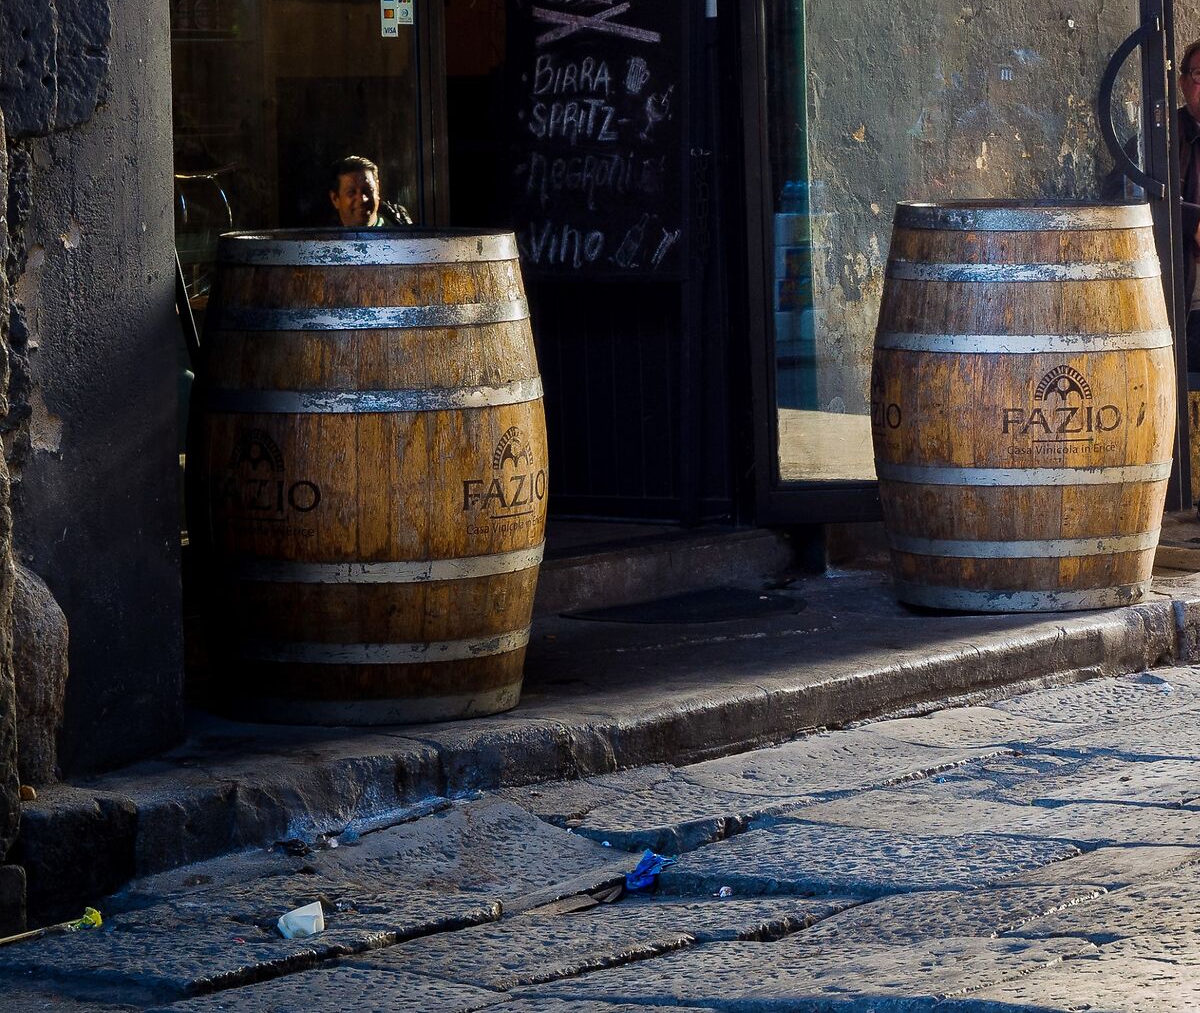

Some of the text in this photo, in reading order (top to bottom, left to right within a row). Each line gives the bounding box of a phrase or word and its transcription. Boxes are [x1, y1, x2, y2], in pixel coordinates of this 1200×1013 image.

[872, 402, 901, 429] ZIO
[1002, 404, 1121, 434] FAZIO
[1007, 444, 1115, 455] Casa Vinicola in Erice
[207, 479, 321, 512] AZIO
[463, 469, 546, 511] FAZIO
[466, 524, 489, 535] Casa
